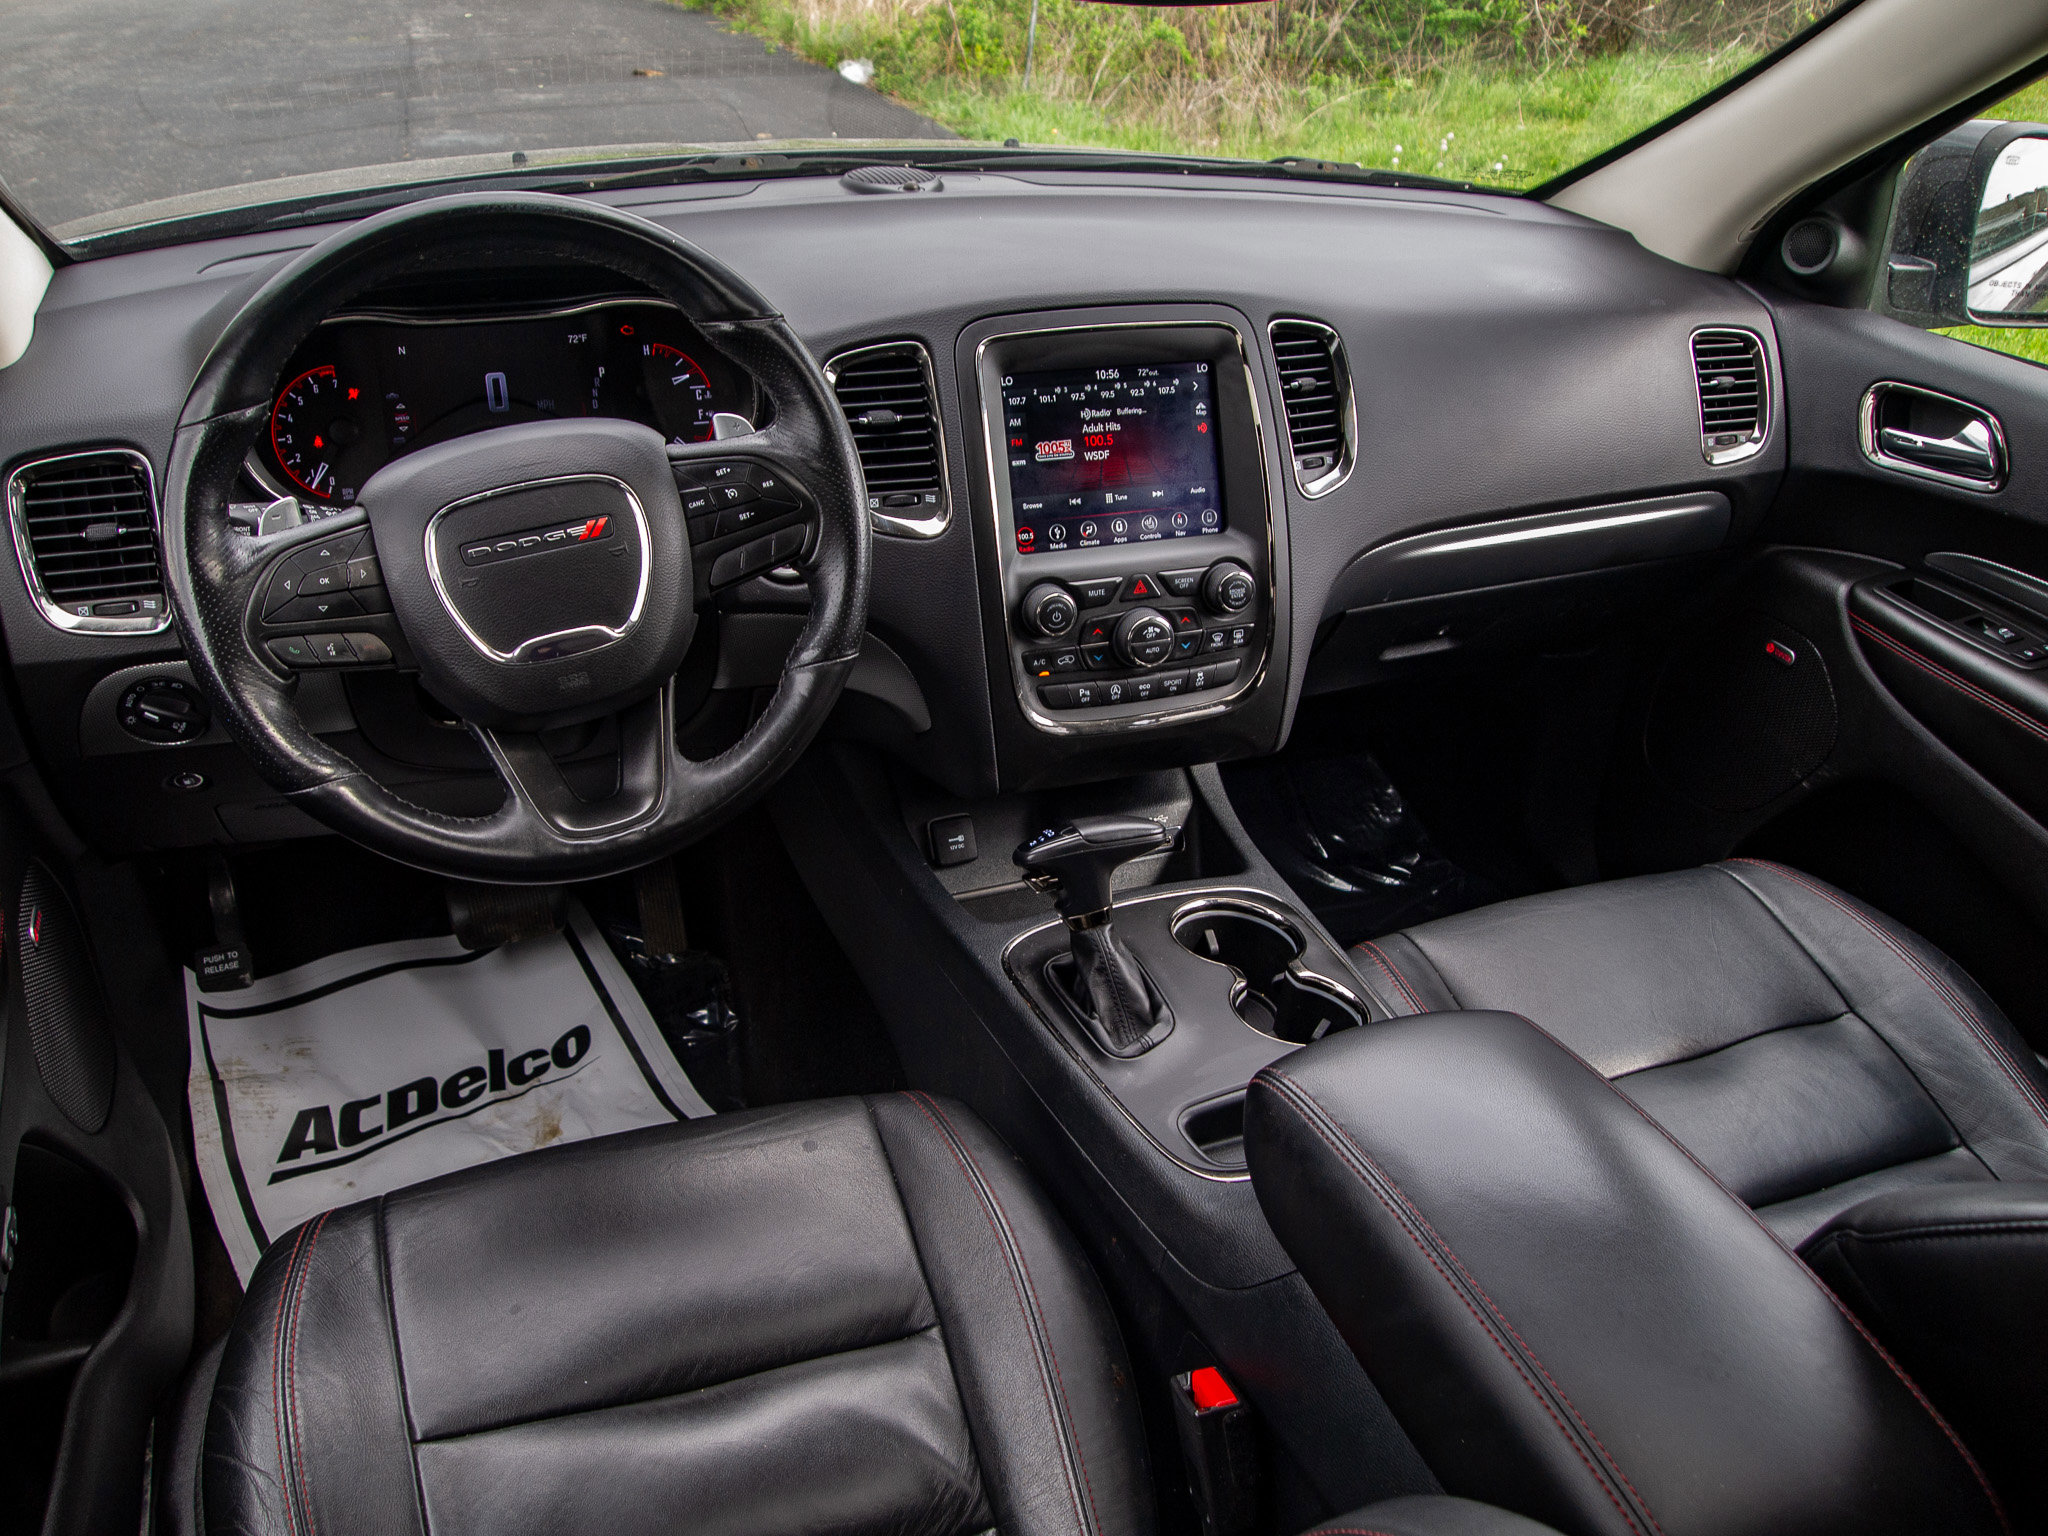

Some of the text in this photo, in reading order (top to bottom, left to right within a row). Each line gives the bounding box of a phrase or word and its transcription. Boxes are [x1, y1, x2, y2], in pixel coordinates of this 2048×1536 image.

[398, 346, 406, 355] N
[598, 366, 605, 378] P
[1196, 363, 1209, 373] LO
[1095, 369, 1120, 380] 10:56
[332, 379, 338, 389] 7
[1000, 376, 1014, 387] LO
[313, 384, 319, 394] 6
[485, 371, 510, 413] 0
[1130, 388, 1145, 397] 92.3
[1158, 386, 1176, 395] 107.5
[1039, 394, 1057, 404] 101.1
[1070, 393, 1086, 401] 97.5
[1100, 390, 1115, 399] 99.5
[297, 396, 304, 406] 5
[1008, 396, 1026, 406] 107.7
[1009, 418, 1022, 427] AM
[1082, 421, 1121, 434] Adult Hits
[286, 434, 292, 444] 3
[1011, 438, 1023, 447] FM
[1084, 434, 1114, 447] 100.5
[295, 453, 301, 463] 2
[1084, 449, 1110, 461] WSDF
[1022, 486, 1206, 510] Browse Tune Audio
[468, 525, 588, 558] DODGE
[319, 577, 330, 585] OK
[1174, 577, 1194, 585] SCREEN
[1088, 588, 1106, 597] MUTE
[1033, 658, 1046, 666] A/C
[1163, 678, 1182, 687] SPORT
[203, 951, 238, 964] PUSH TO
[204, 960, 239, 975] RELEASE
[276, 1024, 591, 1164] ACDelco
